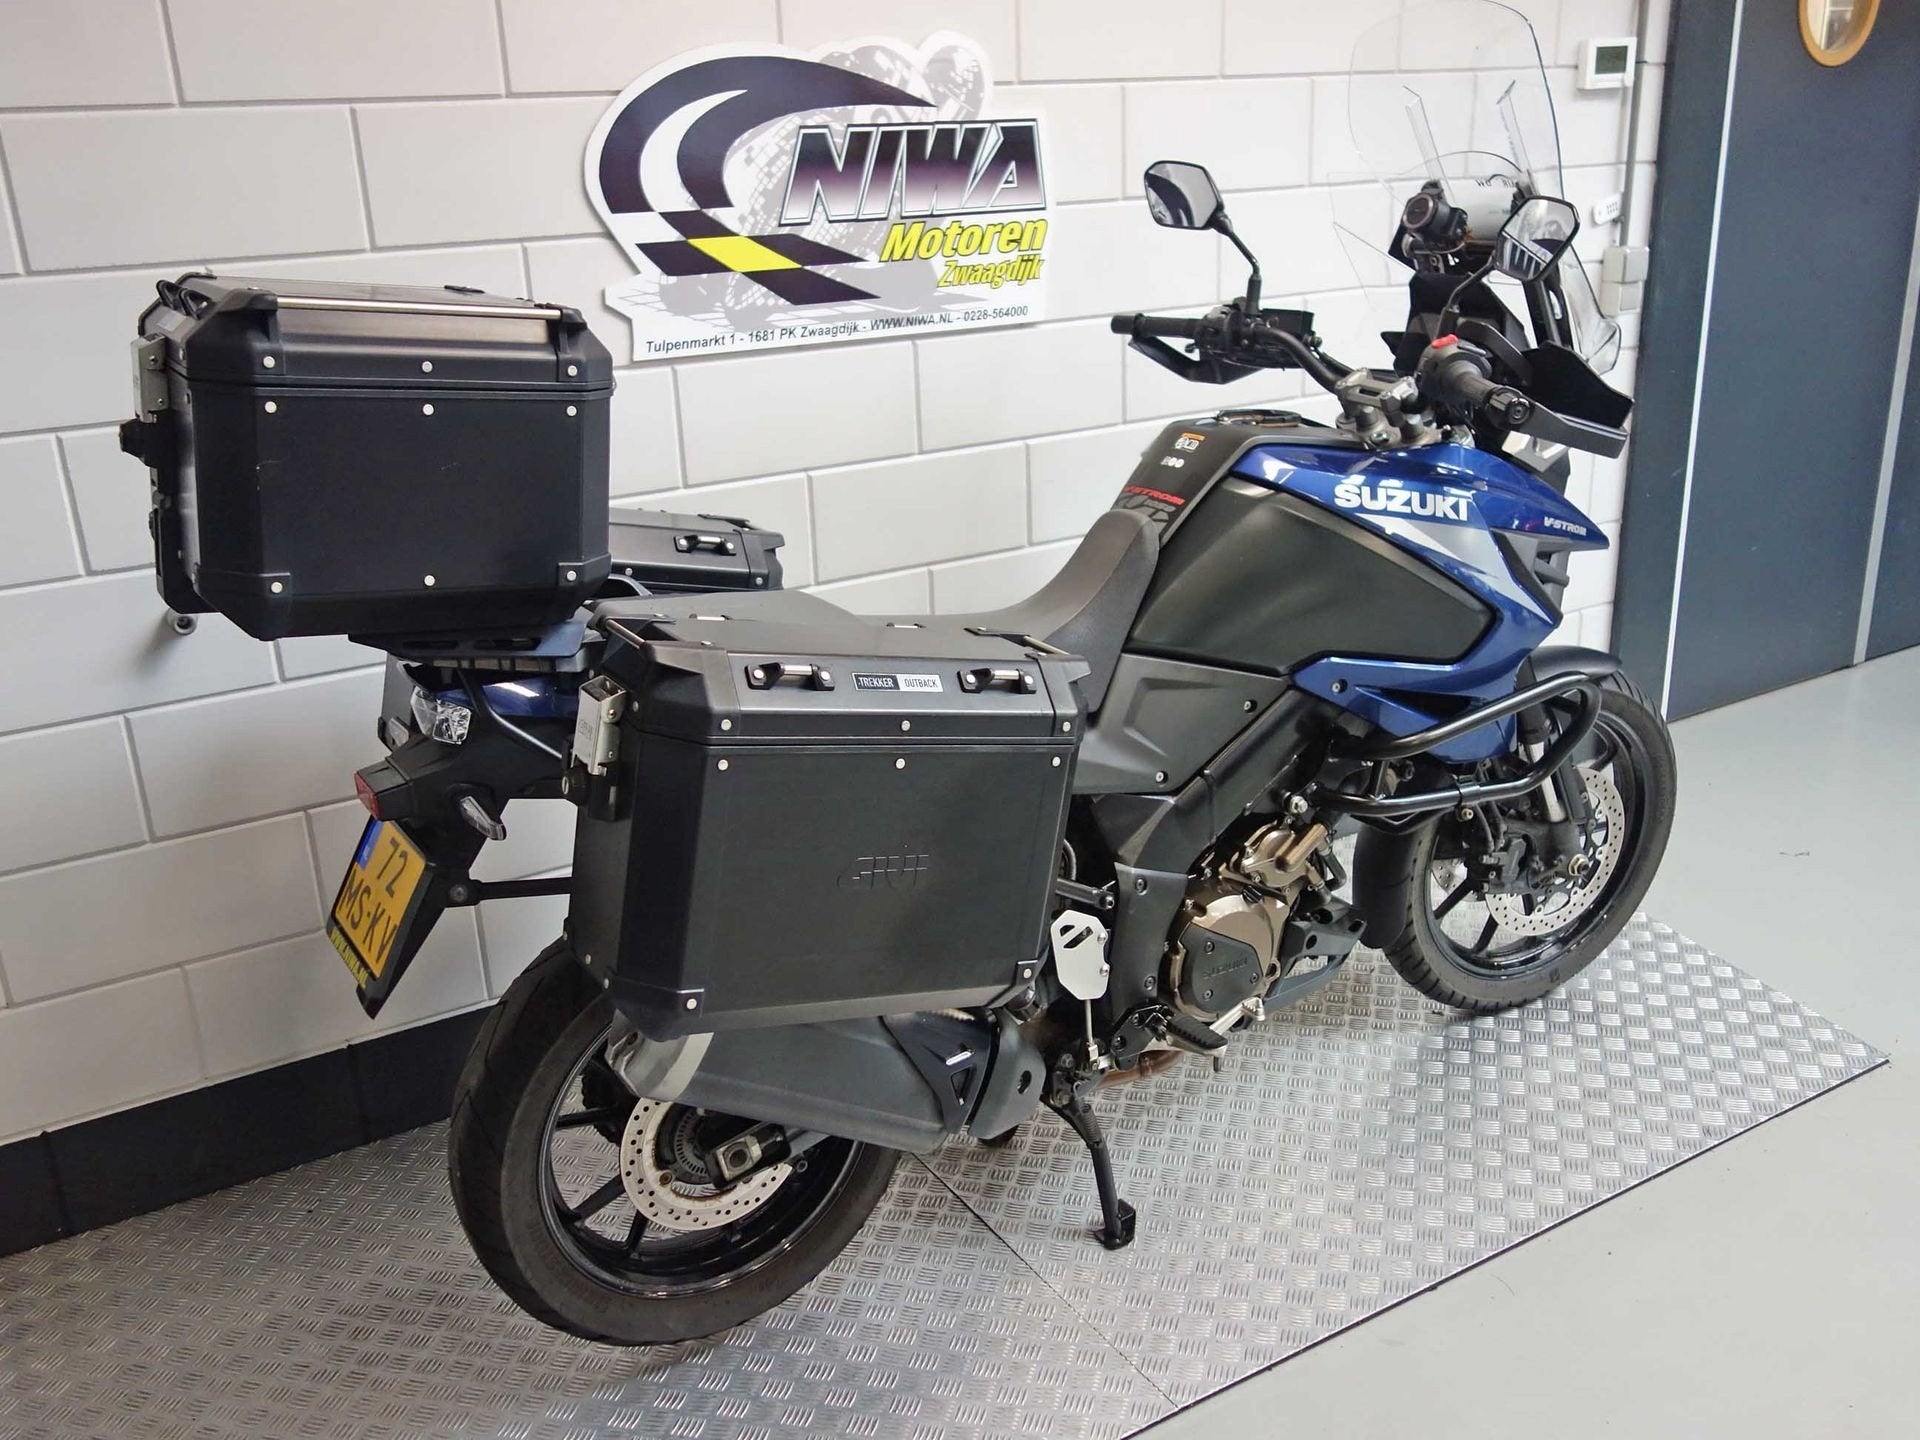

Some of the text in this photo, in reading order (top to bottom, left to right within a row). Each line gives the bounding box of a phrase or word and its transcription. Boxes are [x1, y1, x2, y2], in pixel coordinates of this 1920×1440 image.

[778, 118, 1047, 227] NIWA
[878, 218, 1048, 263] Motoren
[936, 254, 1044, 290] Zwaagdijk
[646, 334, 726, 354] Tulpenmarkt
[729, 333, 736, 345] 1
[749, 330, 775, 344] 1681
[779, 327, 797, 340] PK
[800, 322, 859, 338] Zwaagdijk
[870, 313, 953, 331] WWW.NIWA.NL
[963, 305, 1029, 322] 0228-564000
[1334, 483, 1468, 521] SUZUKI
[1543, 516, 1587, 536] V-STROM
[858, 677, 939, 688] TREKKER OUTBACK
[377, 837, 409, 898] 72
